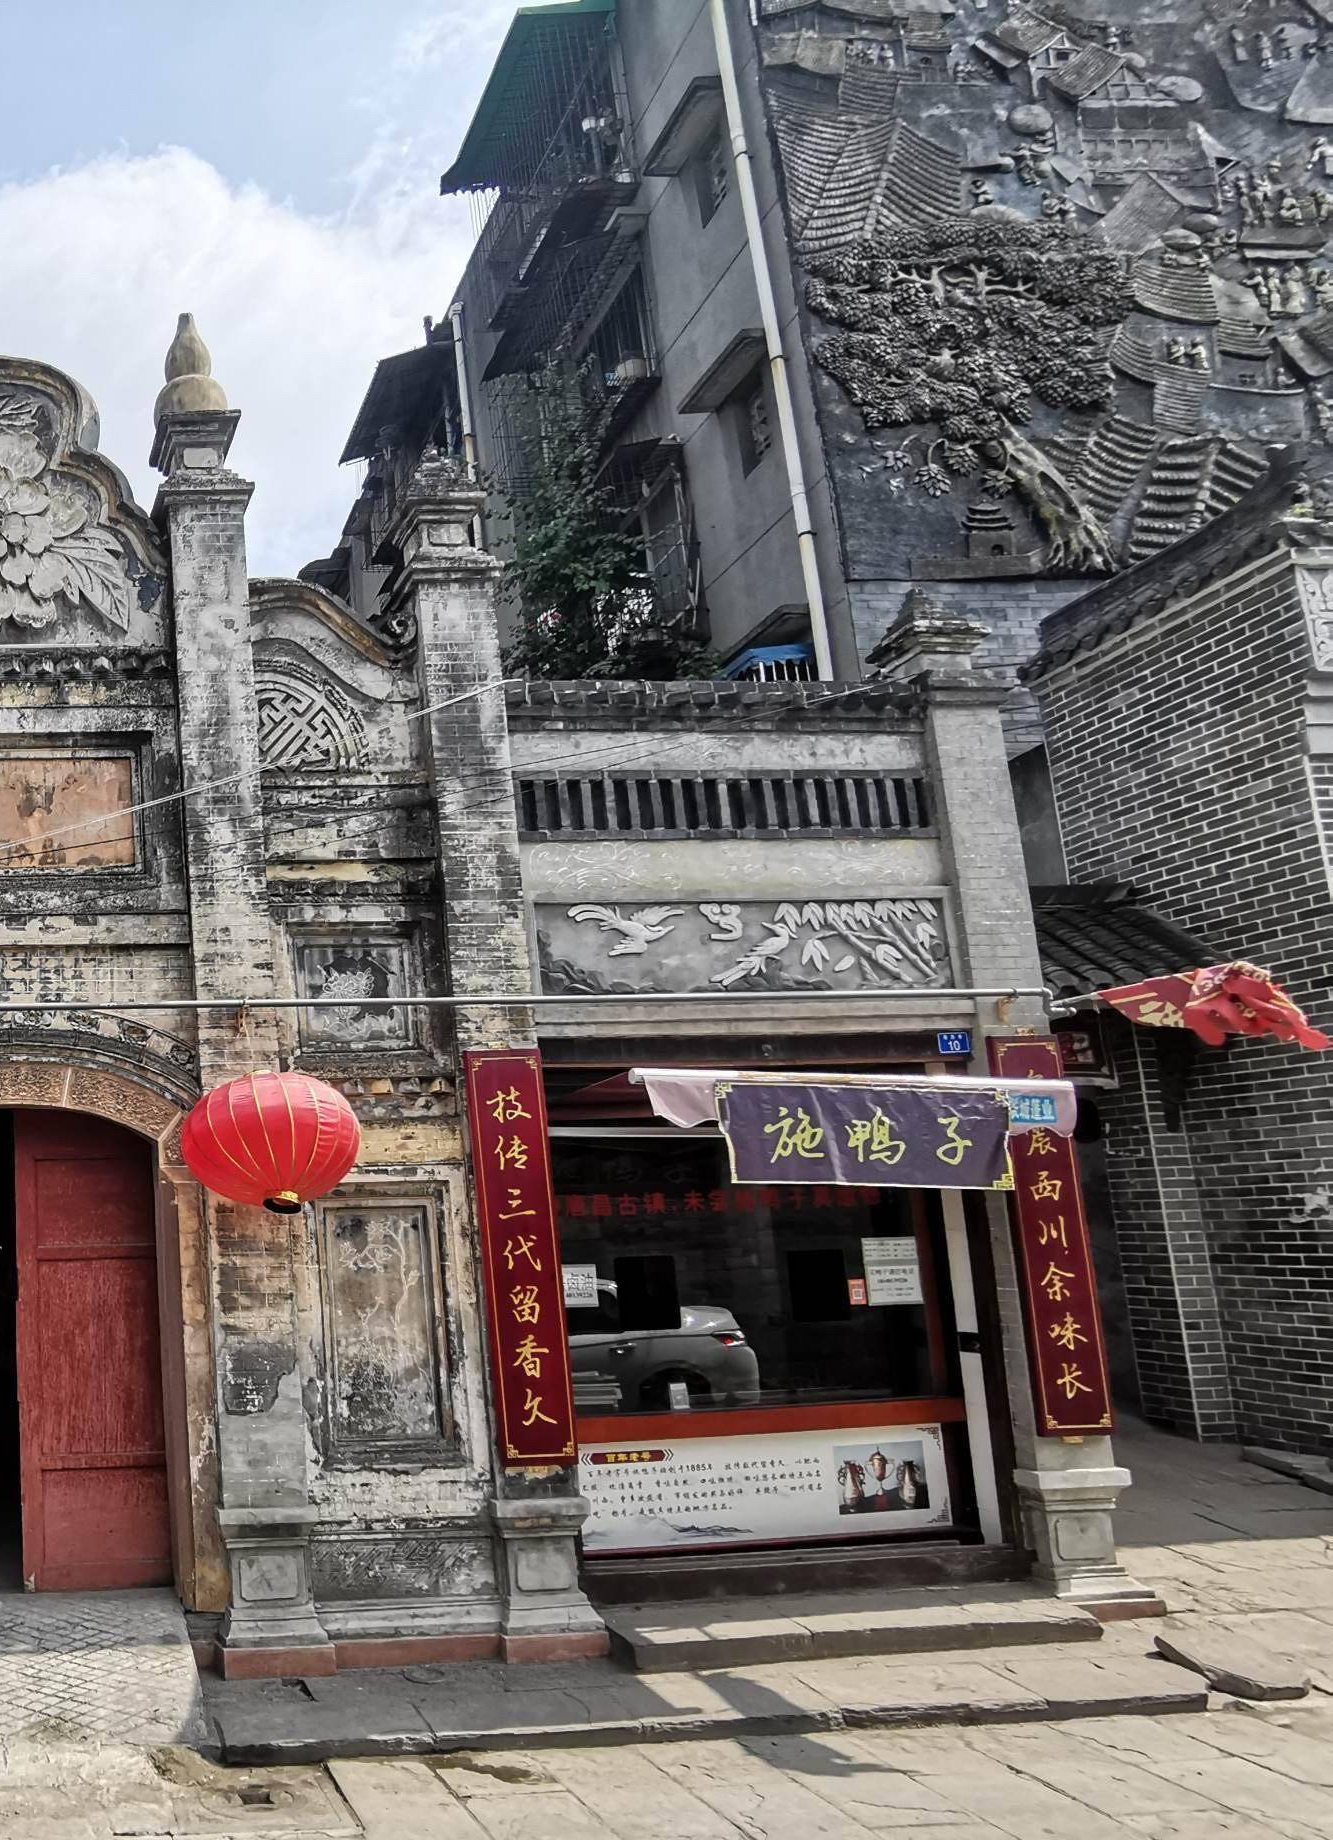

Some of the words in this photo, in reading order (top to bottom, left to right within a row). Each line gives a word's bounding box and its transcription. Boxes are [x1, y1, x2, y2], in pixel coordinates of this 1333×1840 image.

[764, 1107, 973, 1165] 施鸭子
[947, 1040, 961, 1051] 10
[486, 1086, 558, 1426] 技传三代留香久
[1027, 1069, 1094, 1400] 震西川余味长
